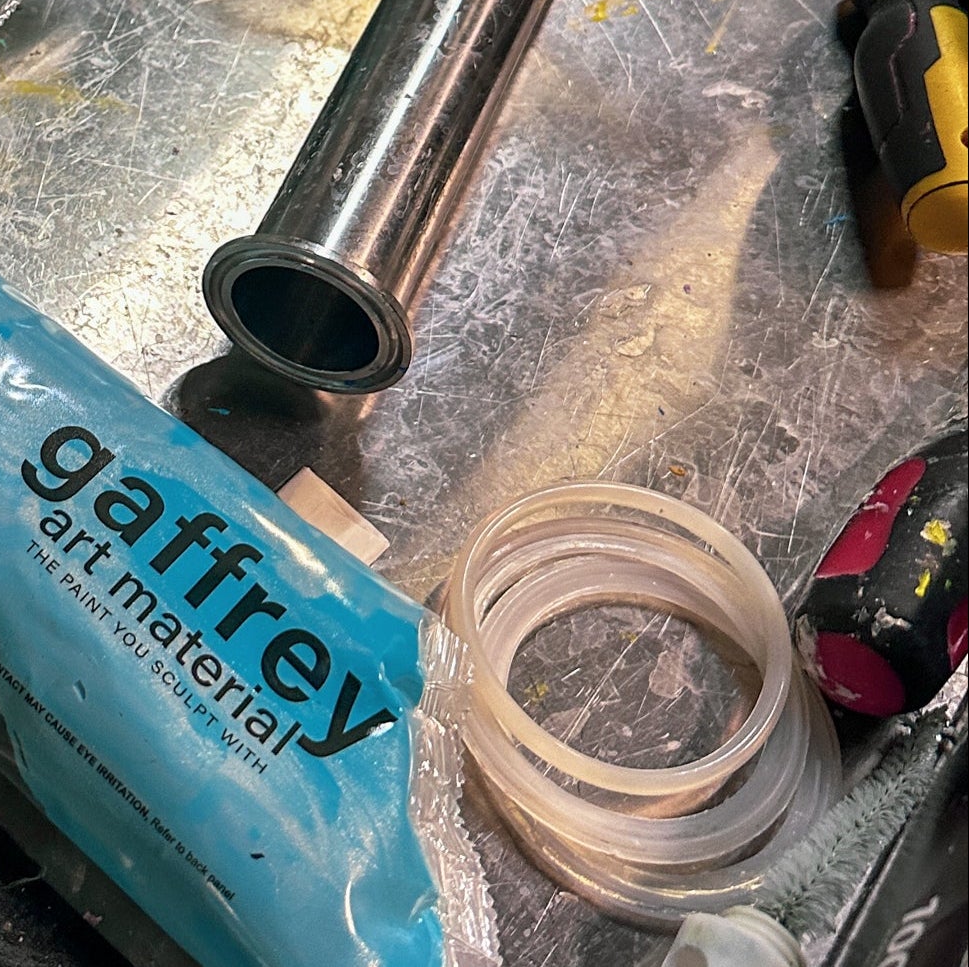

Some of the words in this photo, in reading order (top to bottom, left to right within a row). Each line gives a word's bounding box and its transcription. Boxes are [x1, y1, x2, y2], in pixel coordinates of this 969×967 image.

[20, 425, 399, 758] gaffrey
[26, 539, 61, 575] THE
[59, 572, 113, 621] PAINT
[112, 620, 150, 659] YOU
[150, 659, 220, 728] SCULPT
[220, 727, 268, 775] WITH
[38, 508, 113, 577] art
[107, 570, 303, 756] material
[23, 691, 46, 715] MAY
[44, 712, 79, 748] CAUSE
[76, 743, 99, 767] EYE
[96, 762, 150, 822] IRRITATION,
[150, 816, 177, 844] Refer
[174, 841, 185, 855] to
[185, 850, 210, 876] back
